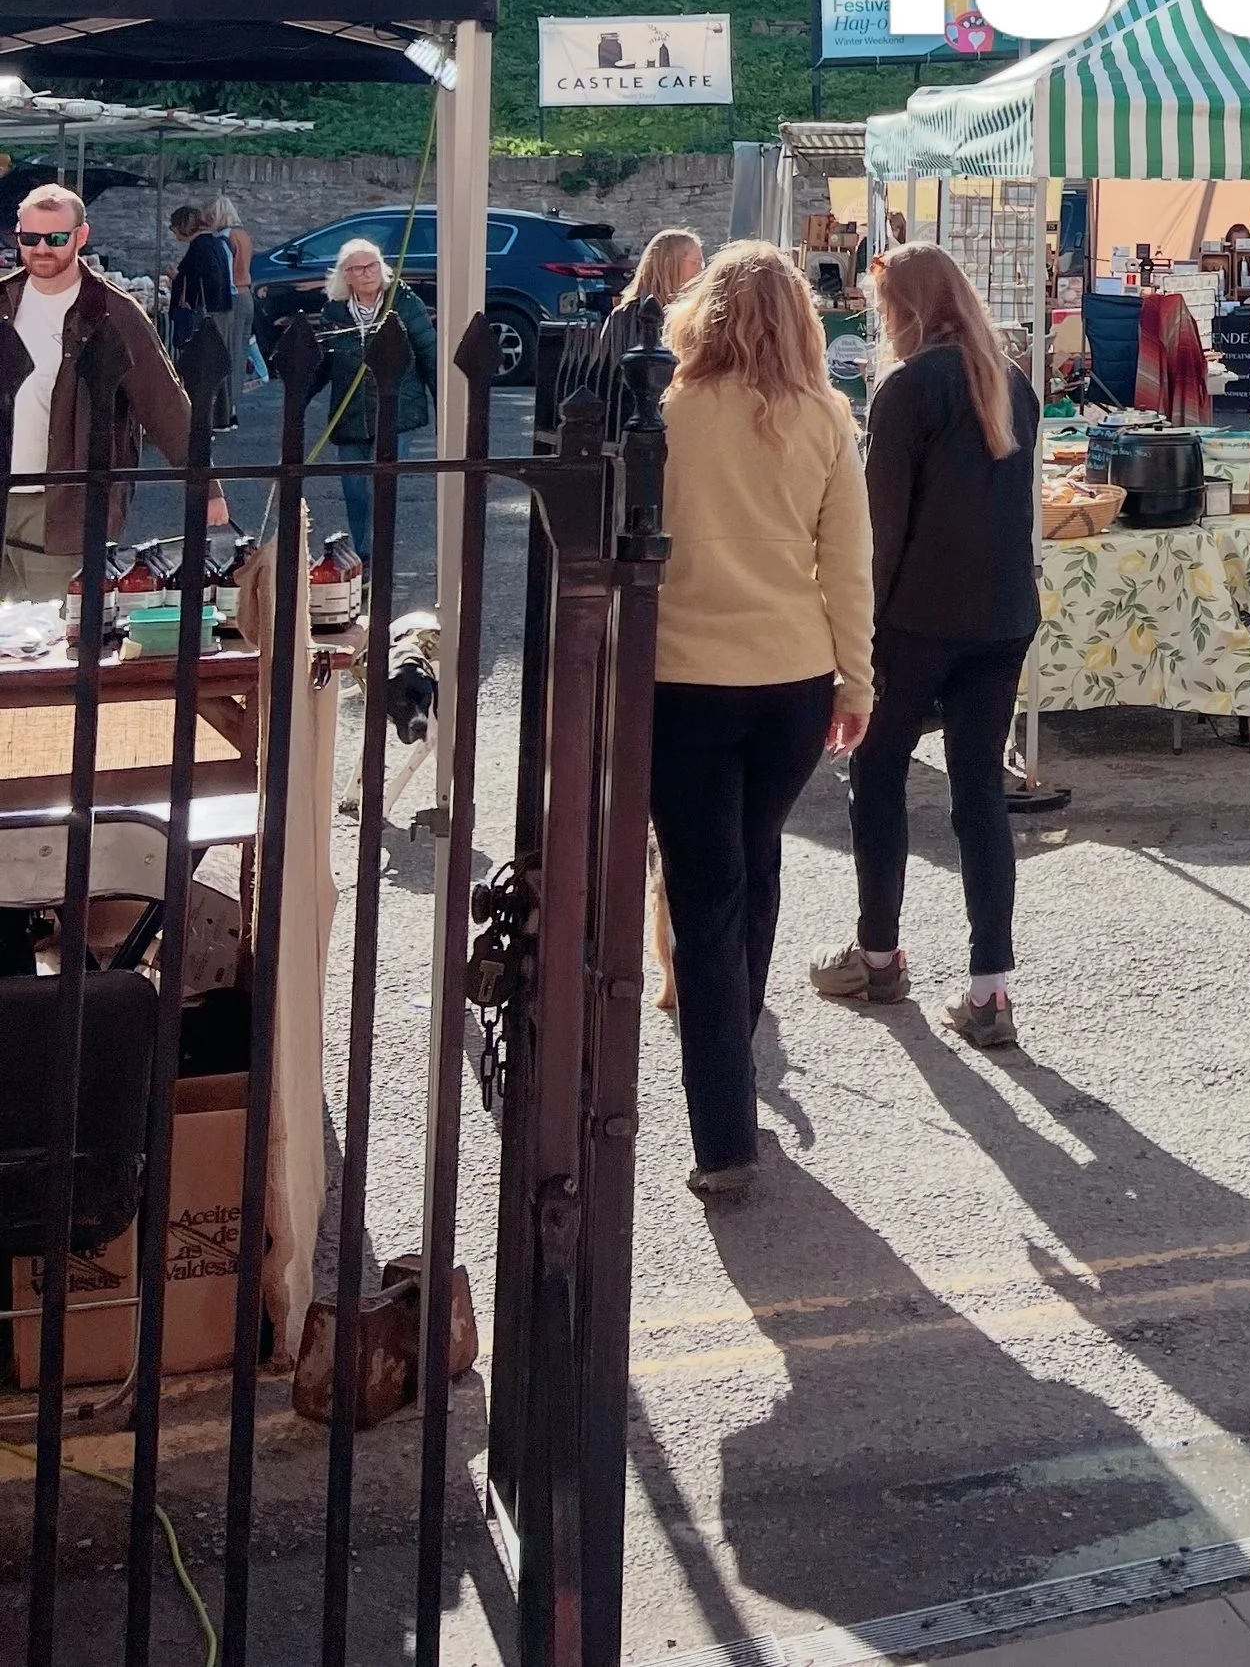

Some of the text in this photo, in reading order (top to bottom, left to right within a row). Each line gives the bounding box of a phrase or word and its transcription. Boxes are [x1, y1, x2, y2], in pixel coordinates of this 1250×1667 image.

[833, 16, 889, 34] Hay-o
[834, 35, 905, 46] Winter Weekend
[557, 75, 713, 90] CASTLE CAFE
[179, 1205, 241, 1226] Aceite
[212, 1225, 239, 1245] de
[166, 1259, 241, 1282] Valdesa
